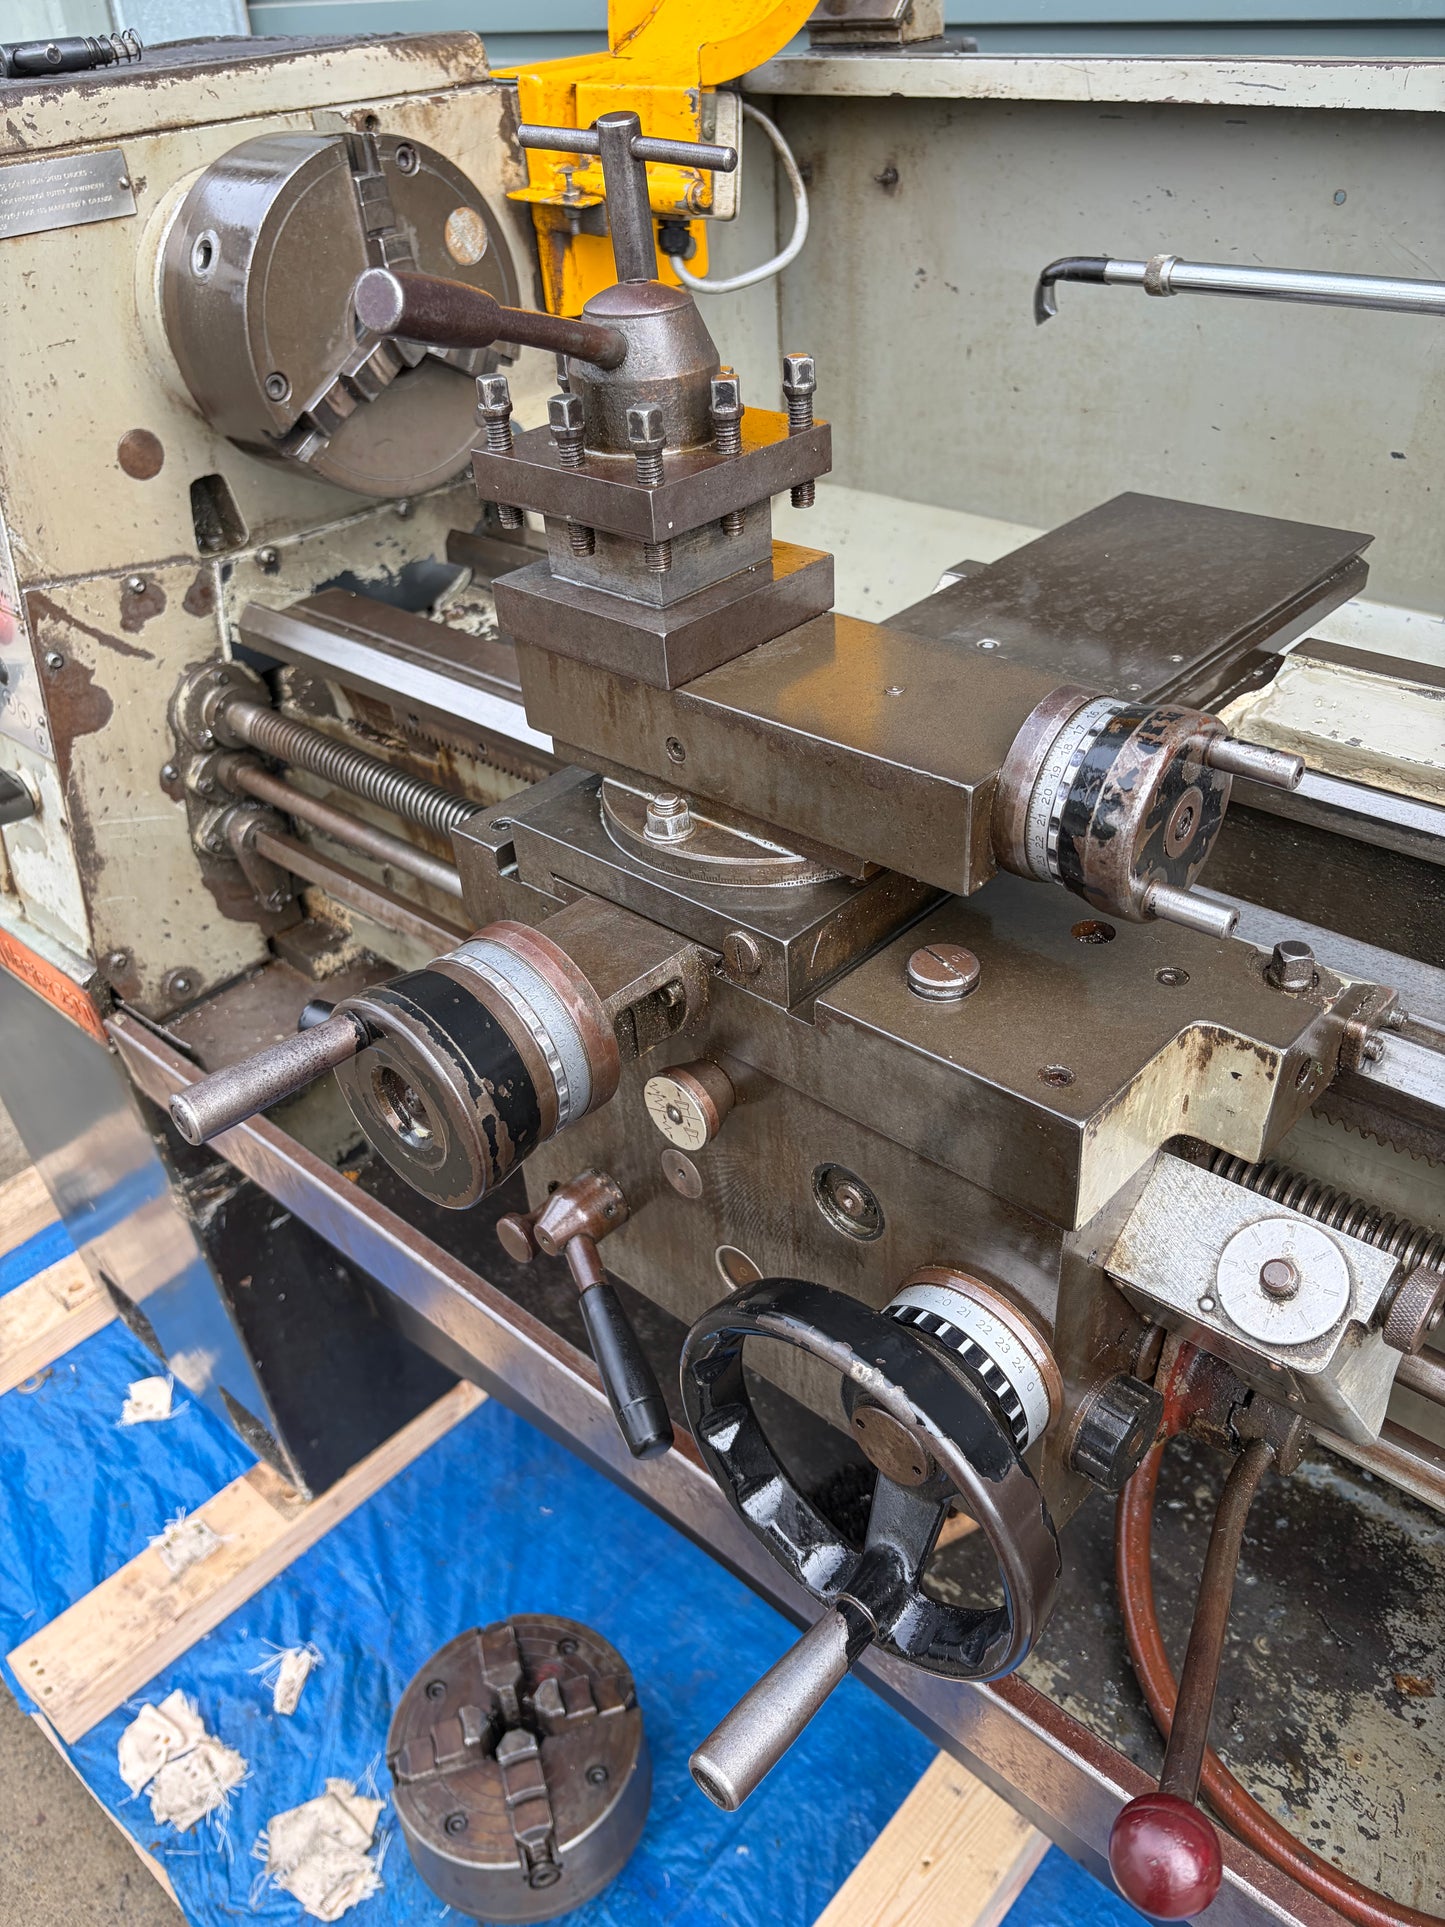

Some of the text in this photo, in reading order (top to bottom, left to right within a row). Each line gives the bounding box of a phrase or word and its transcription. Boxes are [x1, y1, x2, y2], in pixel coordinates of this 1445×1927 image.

[1061, 744, 1073, 756] 1.8
[1050, 765, 1062, 779] 1.9
[1041, 788, 1053, 805] 2.0
[935, 1295, 952, 1307] 20
[956, 1306, 972, 1319] 21
[975, 1319, 993, 1336] 22
[995, 1336, 1011, 1354] 23
[1011, 1356, 1026, 1374] 24
[1026, 1381, 1035, 1392] 0
